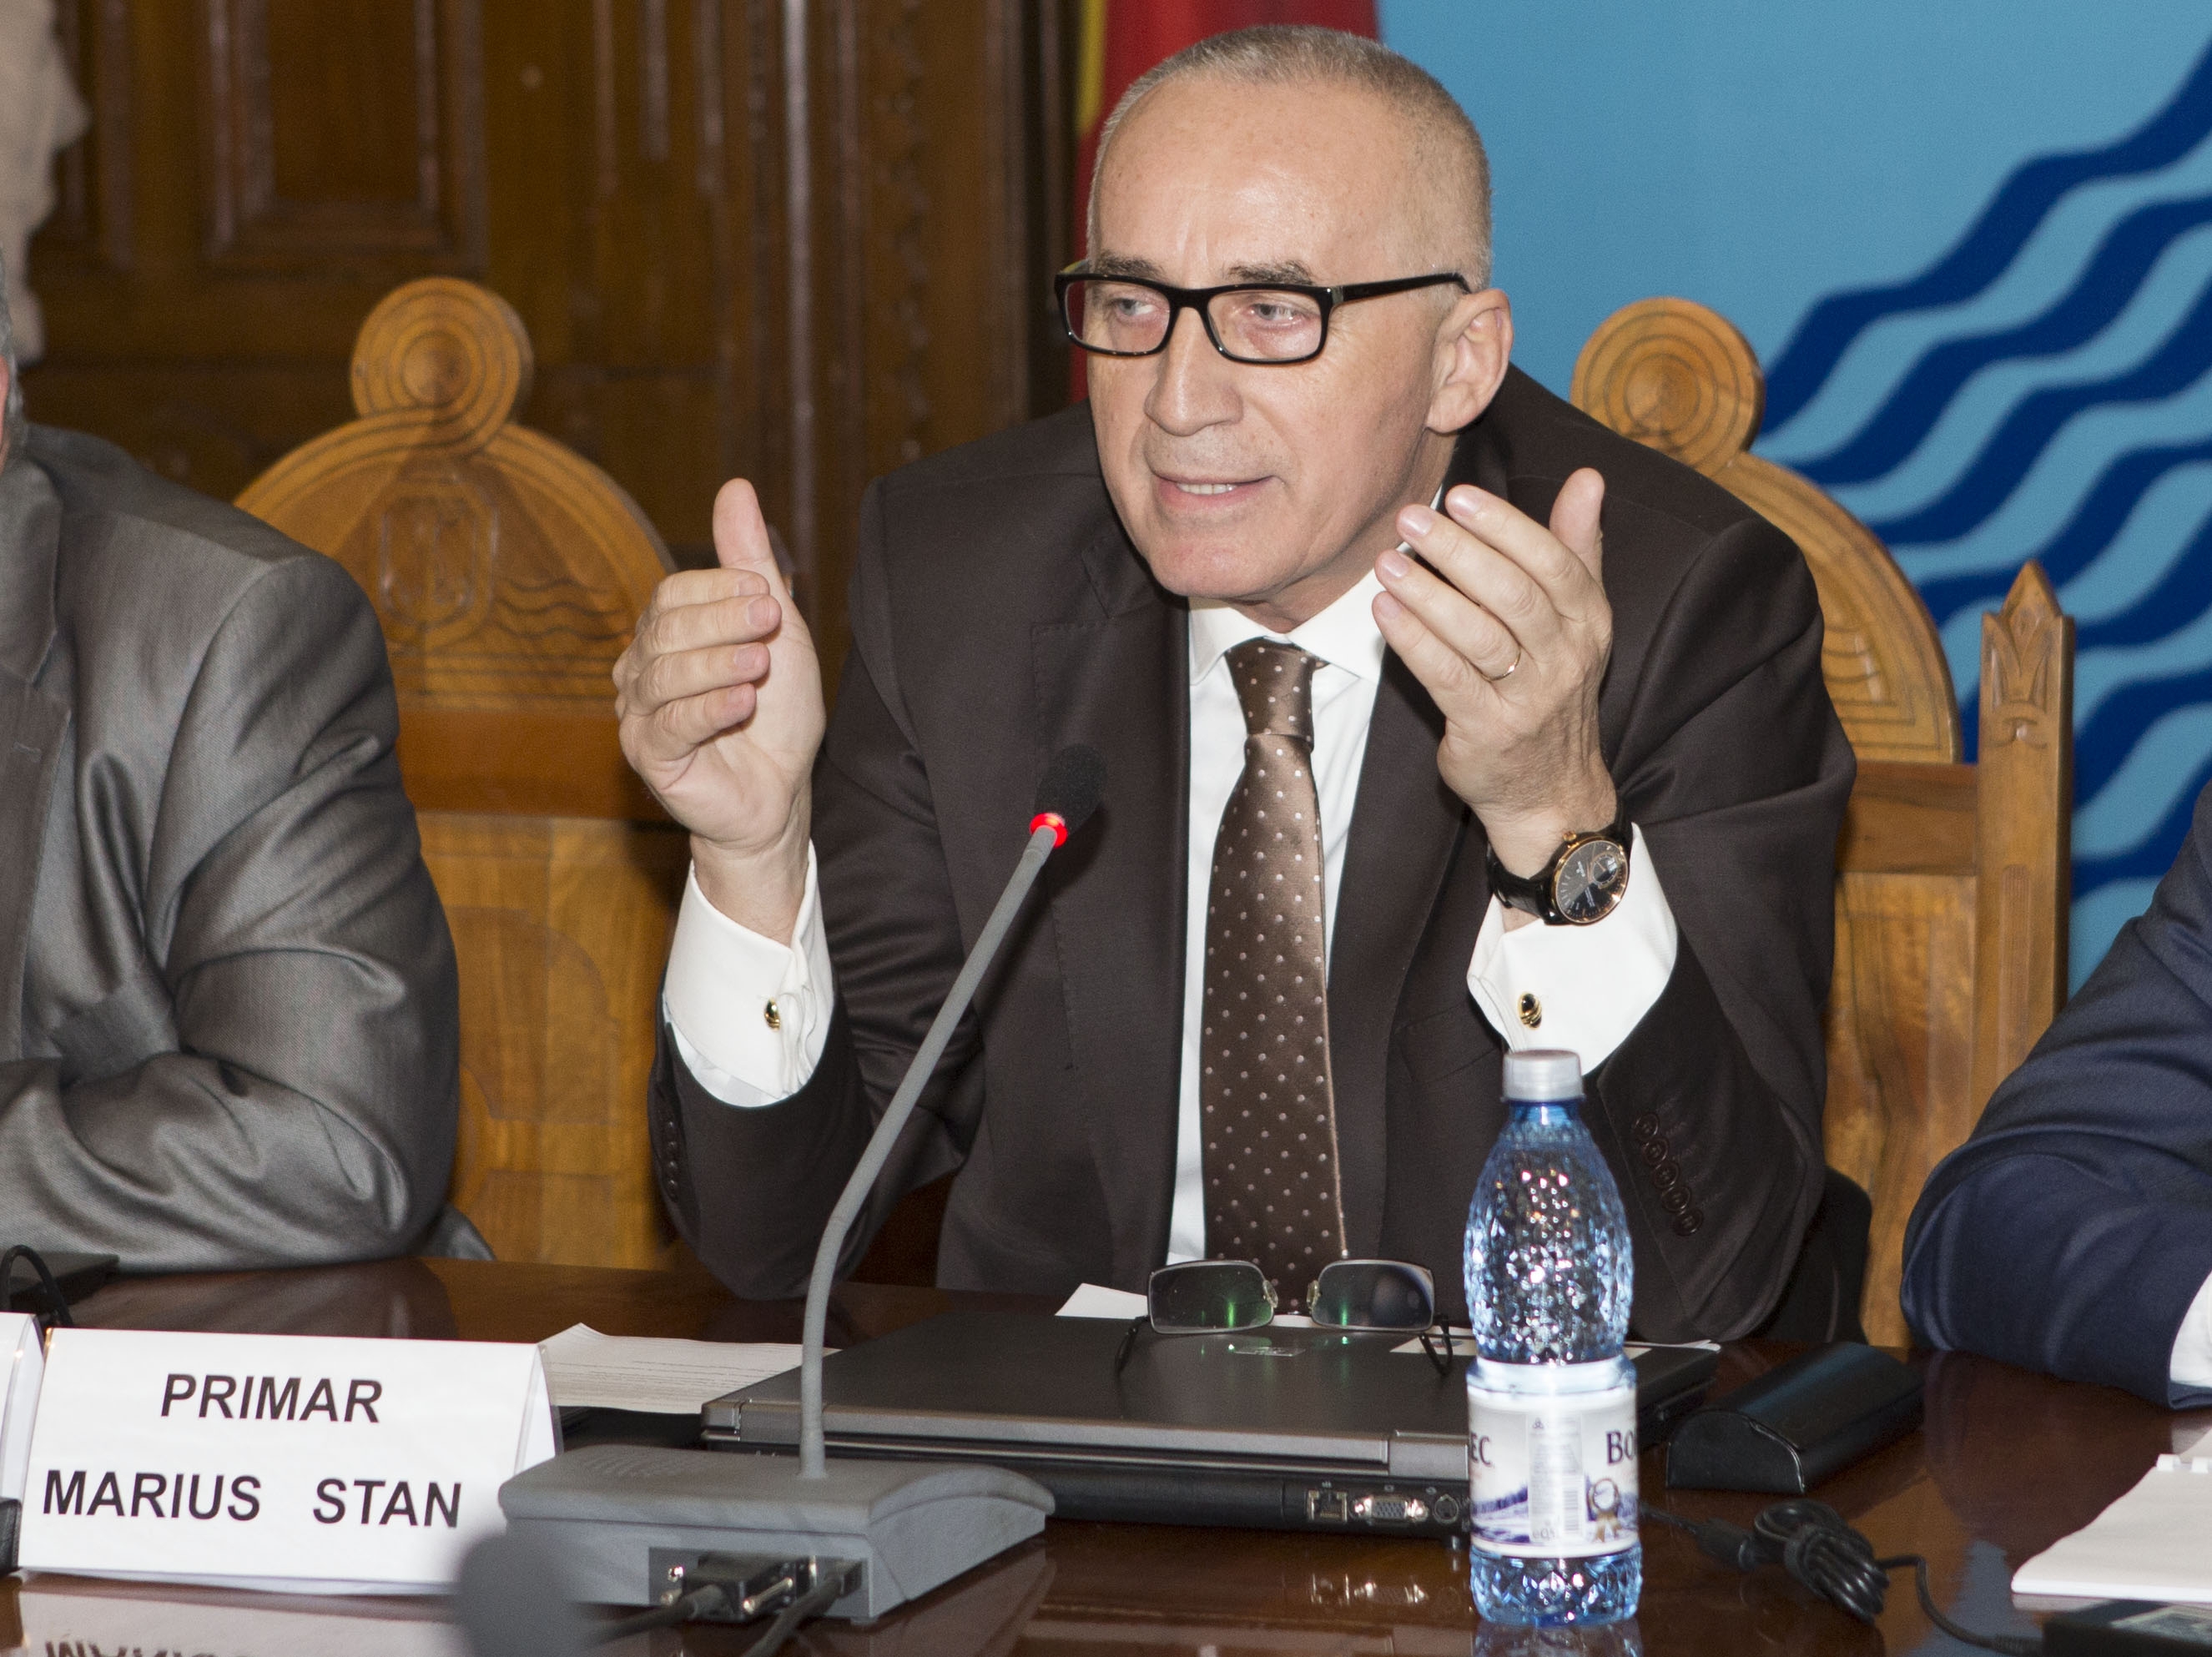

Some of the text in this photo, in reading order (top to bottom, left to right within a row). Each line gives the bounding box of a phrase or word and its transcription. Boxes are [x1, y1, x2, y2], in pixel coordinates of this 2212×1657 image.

[161, 1373, 382, 1423] PRIMAR
[43, 1469, 461, 1529] MARIUS STAN
